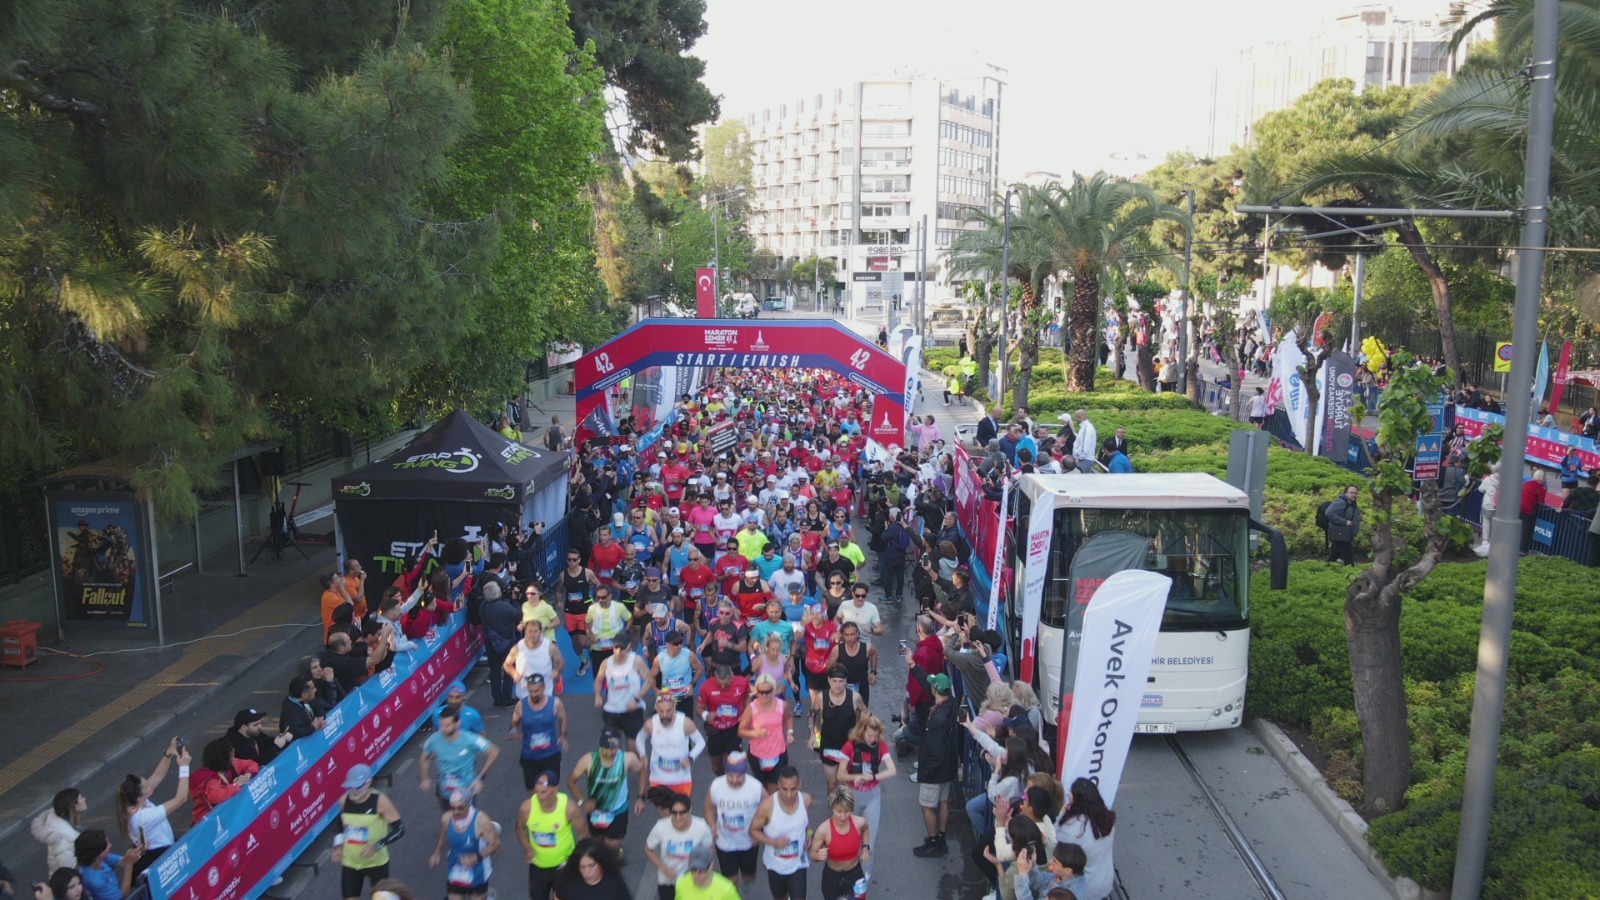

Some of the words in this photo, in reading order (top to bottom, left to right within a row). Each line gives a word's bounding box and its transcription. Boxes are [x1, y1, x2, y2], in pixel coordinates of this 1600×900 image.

[595, 352, 615, 374] 42
[676, 353, 726, 366] START
[742, 354, 801, 367] FINISH
[850, 348, 872, 370] 42
[406, 452, 452, 462] ETAP
[393, 459, 459, 470] TIMING
[97, 506, 120, 515] prime
[1534, 525, 1552, 538] POLİS
[82, 587, 126, 605] Fallout
[1103, 619, 1133, 689] Avek
[1167, 656, 1214, 665] BELEDİYESİ
[1145, 724, 1158, 732] EDM
[1163, 724, 1172, 732] 92
[248, 766, 275, 793] MARATON
[290, 814, 303, 831] Avek
[302, 792, 326, 818] Otomotiv
[719, 798, 750, 811] BOSS
[157, 842, 188, 875] MARATON
